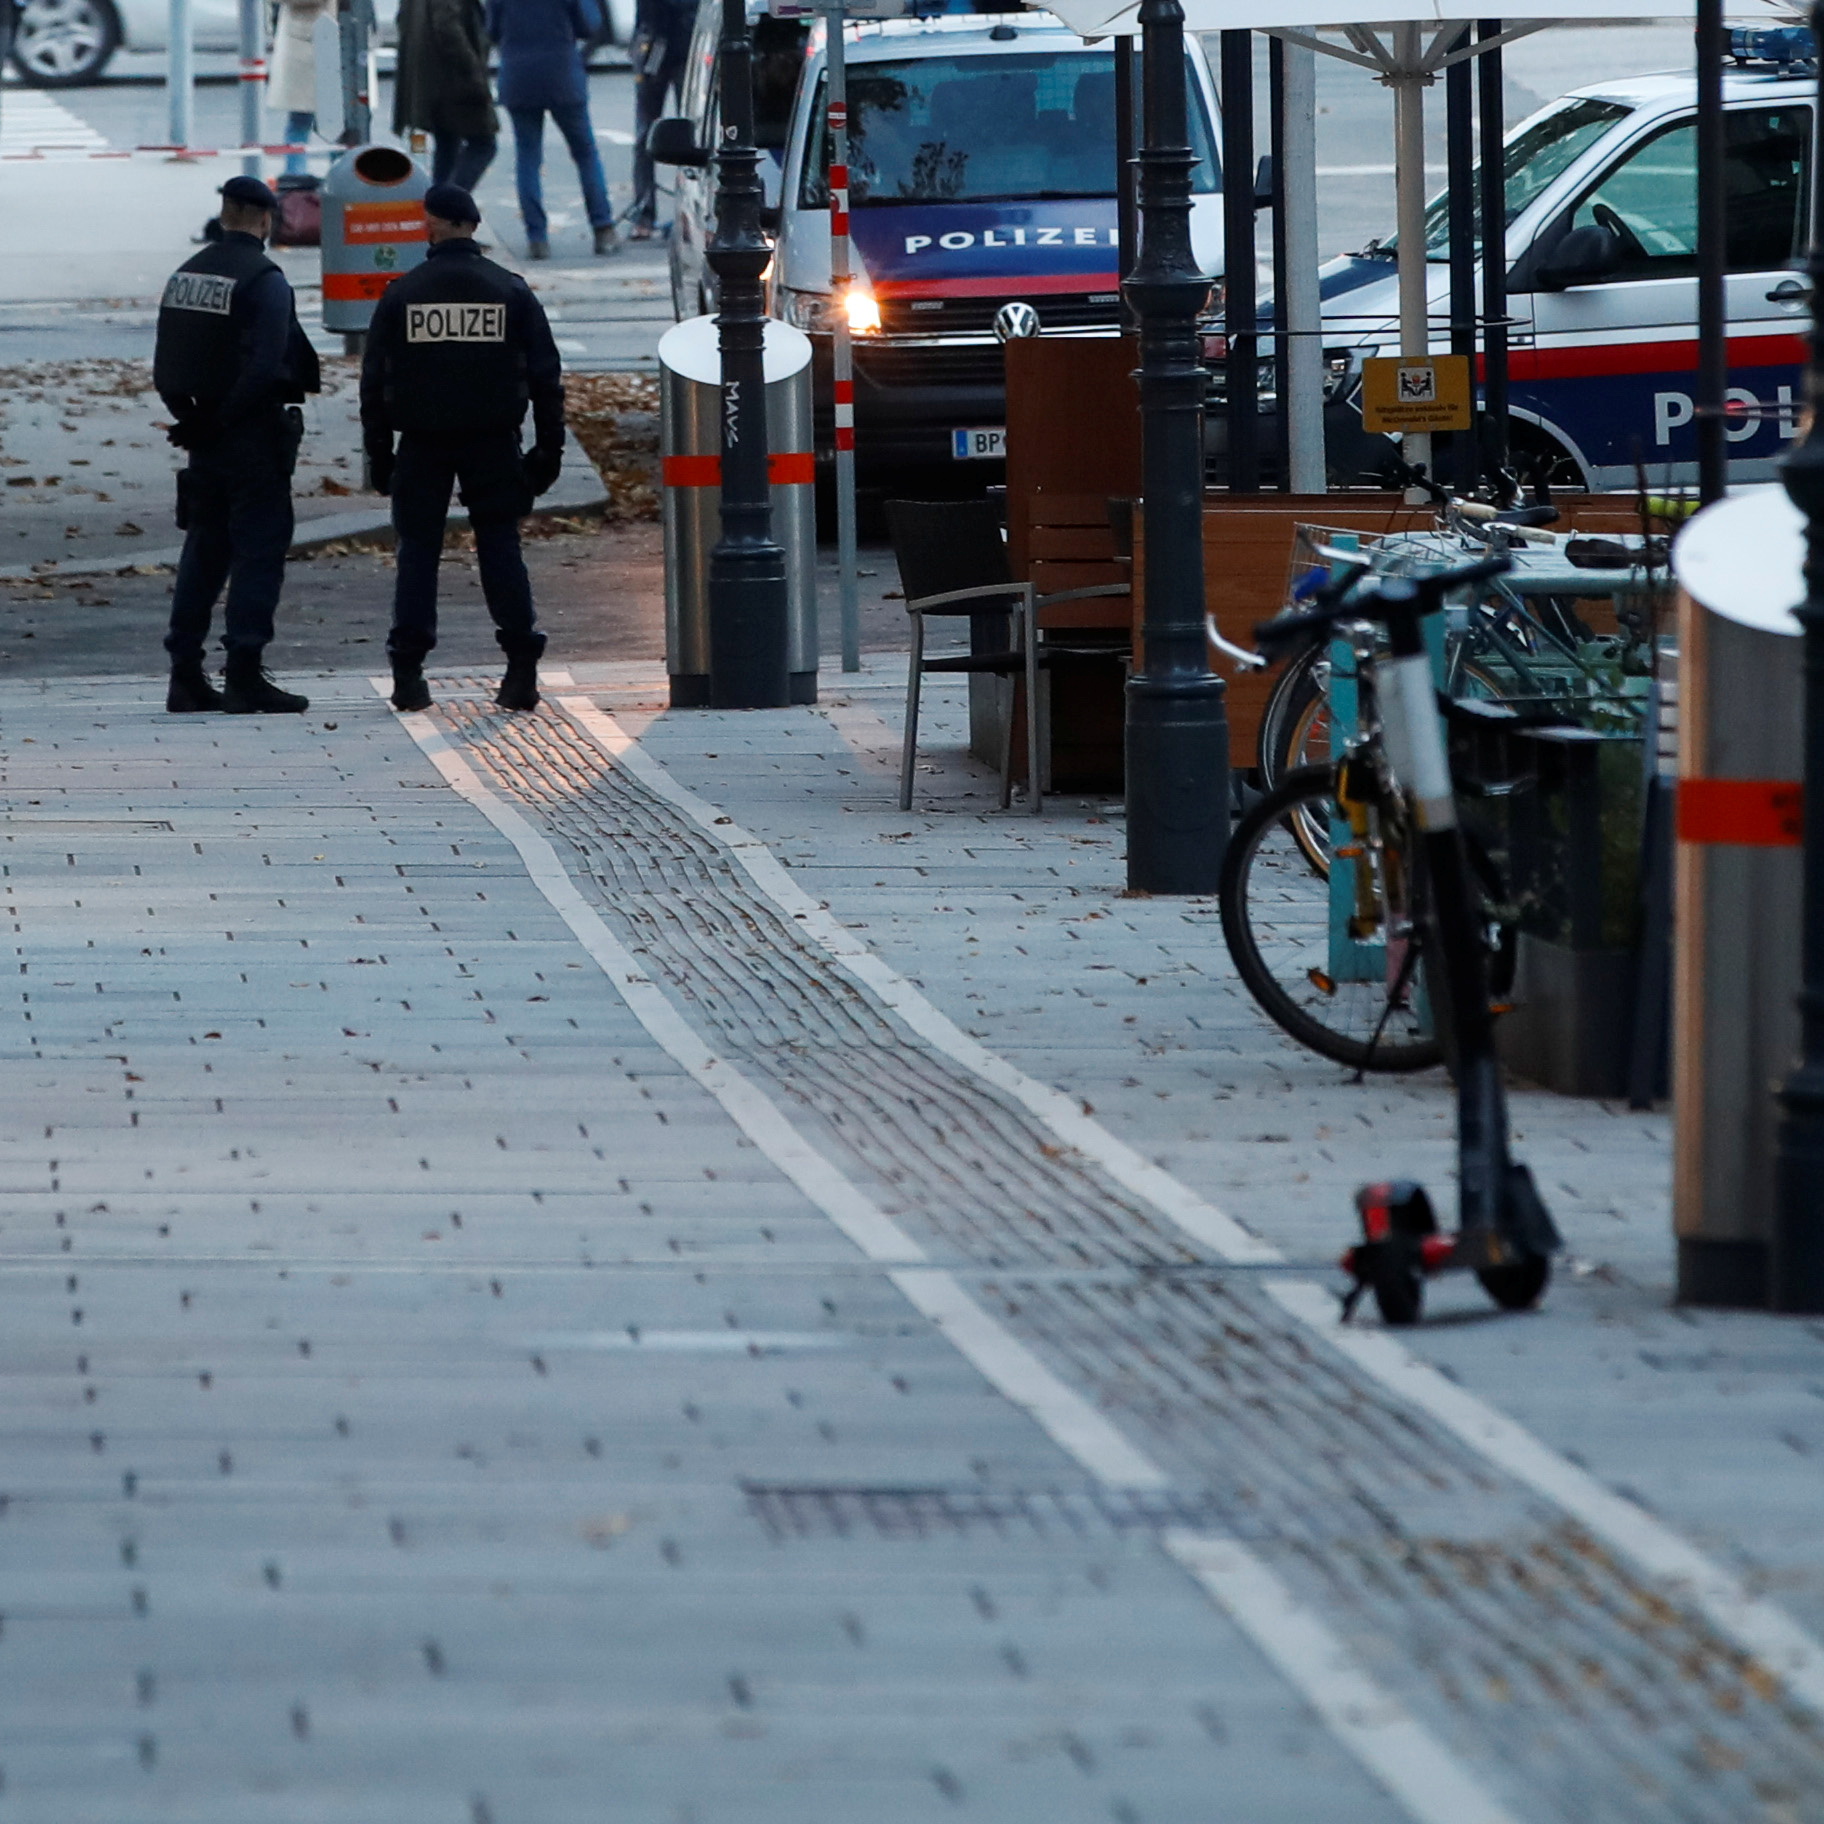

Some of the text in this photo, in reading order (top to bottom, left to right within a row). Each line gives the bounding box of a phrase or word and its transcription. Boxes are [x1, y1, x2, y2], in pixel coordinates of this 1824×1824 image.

[905, 227, 1118, 254] POLIZEI
[163, 275, 230, 312] POLIZEI
[410, 309, 504, 339] POLIZEI
